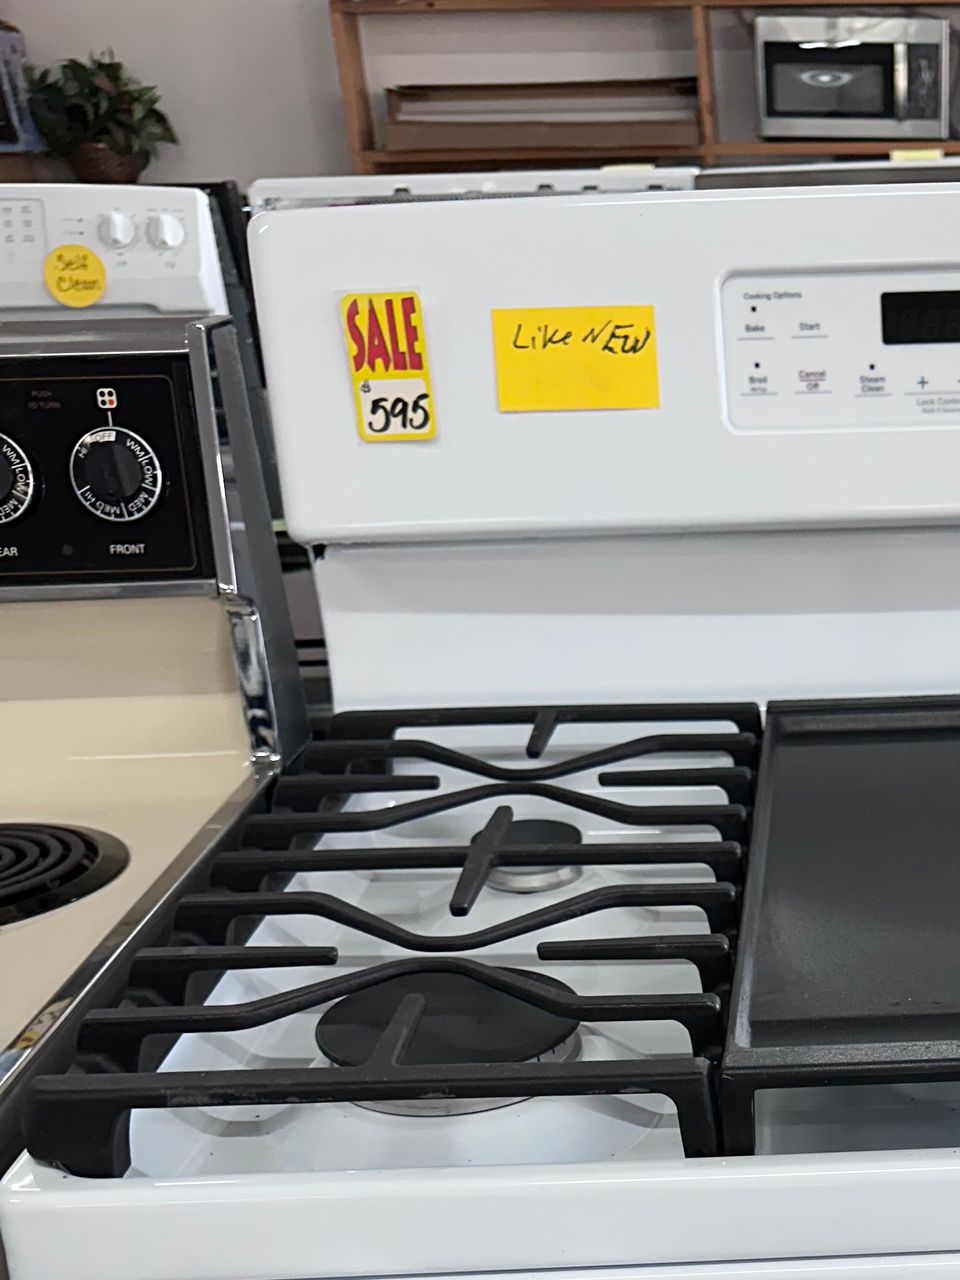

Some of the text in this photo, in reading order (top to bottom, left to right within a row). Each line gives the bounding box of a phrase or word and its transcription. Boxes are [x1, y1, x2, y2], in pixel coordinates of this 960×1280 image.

[55, 276, 101, 293] Clean
[743, 290, 802, 301] Cooking Options
[745, 323, 765, 333] Bake
[799, 322, 821, 331] Start
[346, 296, 424, 373] SALE
[512, 320, 651, 355] Like NEW
[748, 376, 768, 385] Broil
[798, 370, 827, 379] Cancel
[859, 375, 887, 384] Steam
[806, 382, 820, 392] Off
[860, 384, 885, 393] Clean
[368, 393, 430, 433] 595
[2, 444, 20, 469] WM
[126, 438, 145, 461] WM
[142, 459, 154, 486] LOW
[15, 466, 28, 496] LOW
[128, 490, 150, 512] MED
[109, 544, 145, 555] FRONT
